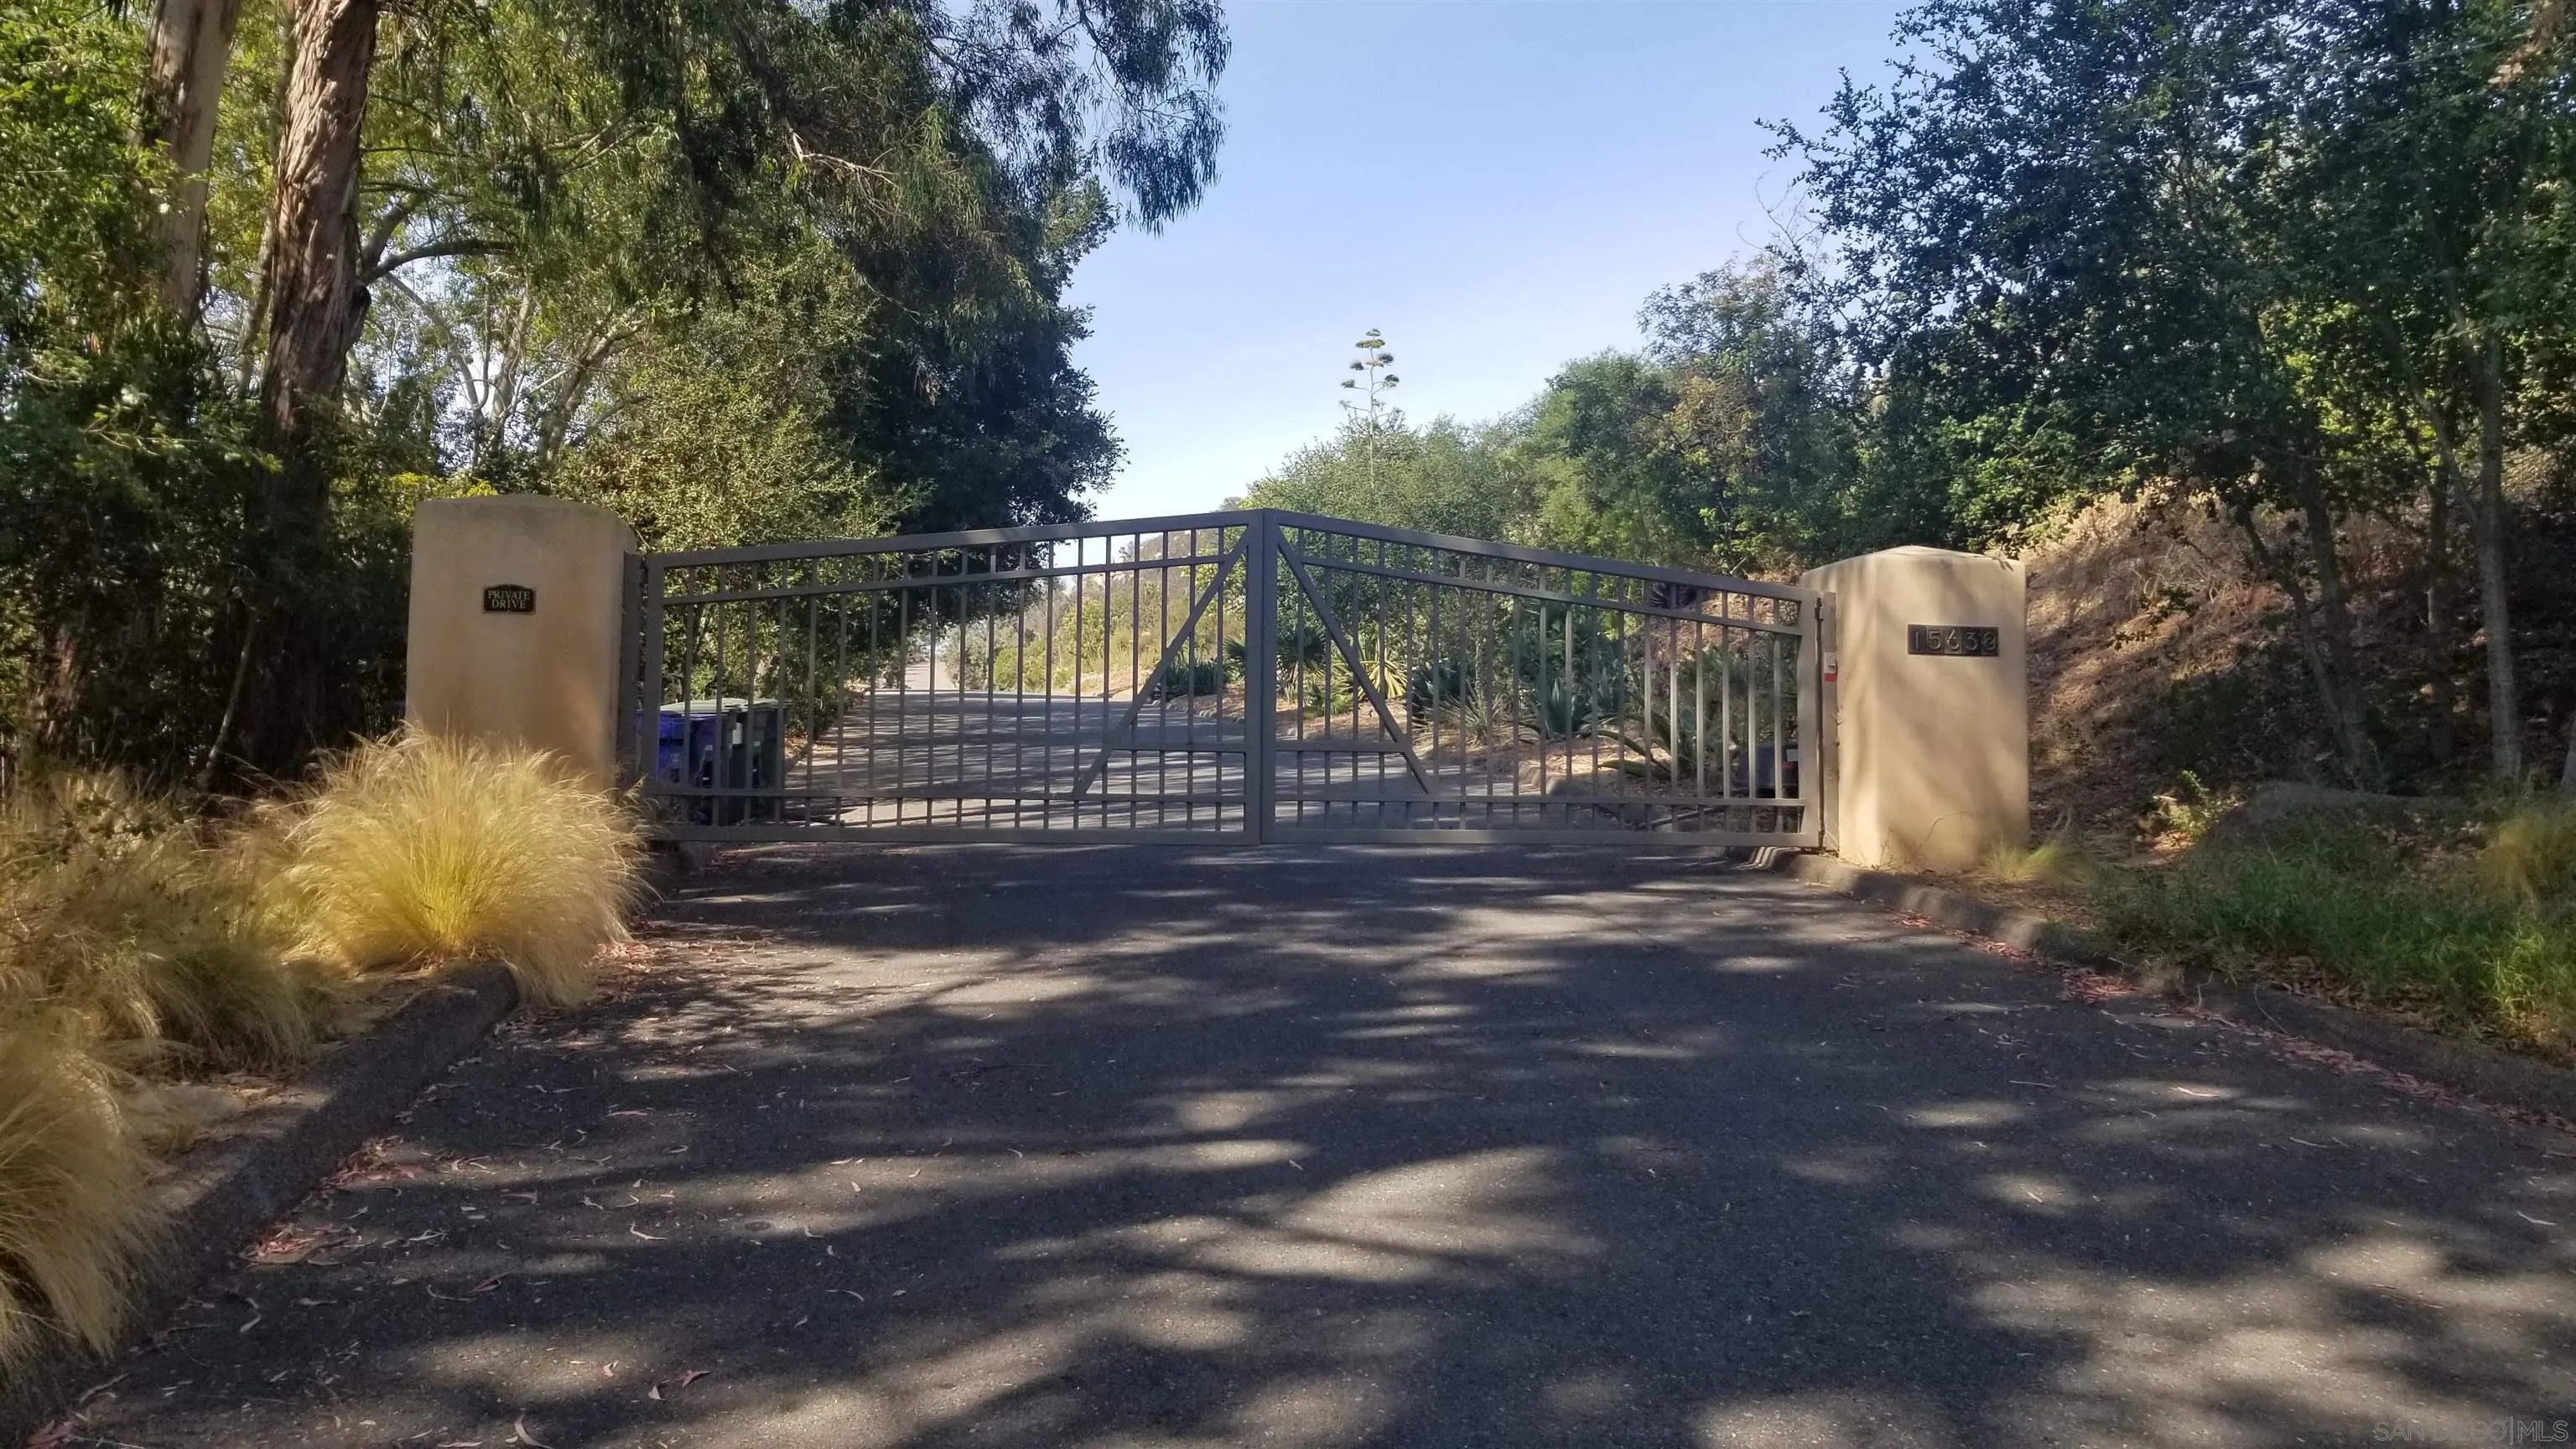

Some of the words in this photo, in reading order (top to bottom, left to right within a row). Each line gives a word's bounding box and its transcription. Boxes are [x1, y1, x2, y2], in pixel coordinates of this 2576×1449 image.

[488, 589, 530, 600] PRIVATE
[491, 599, 527, 609] DRIVE
[1914, 629, 1996, 651] 15638
